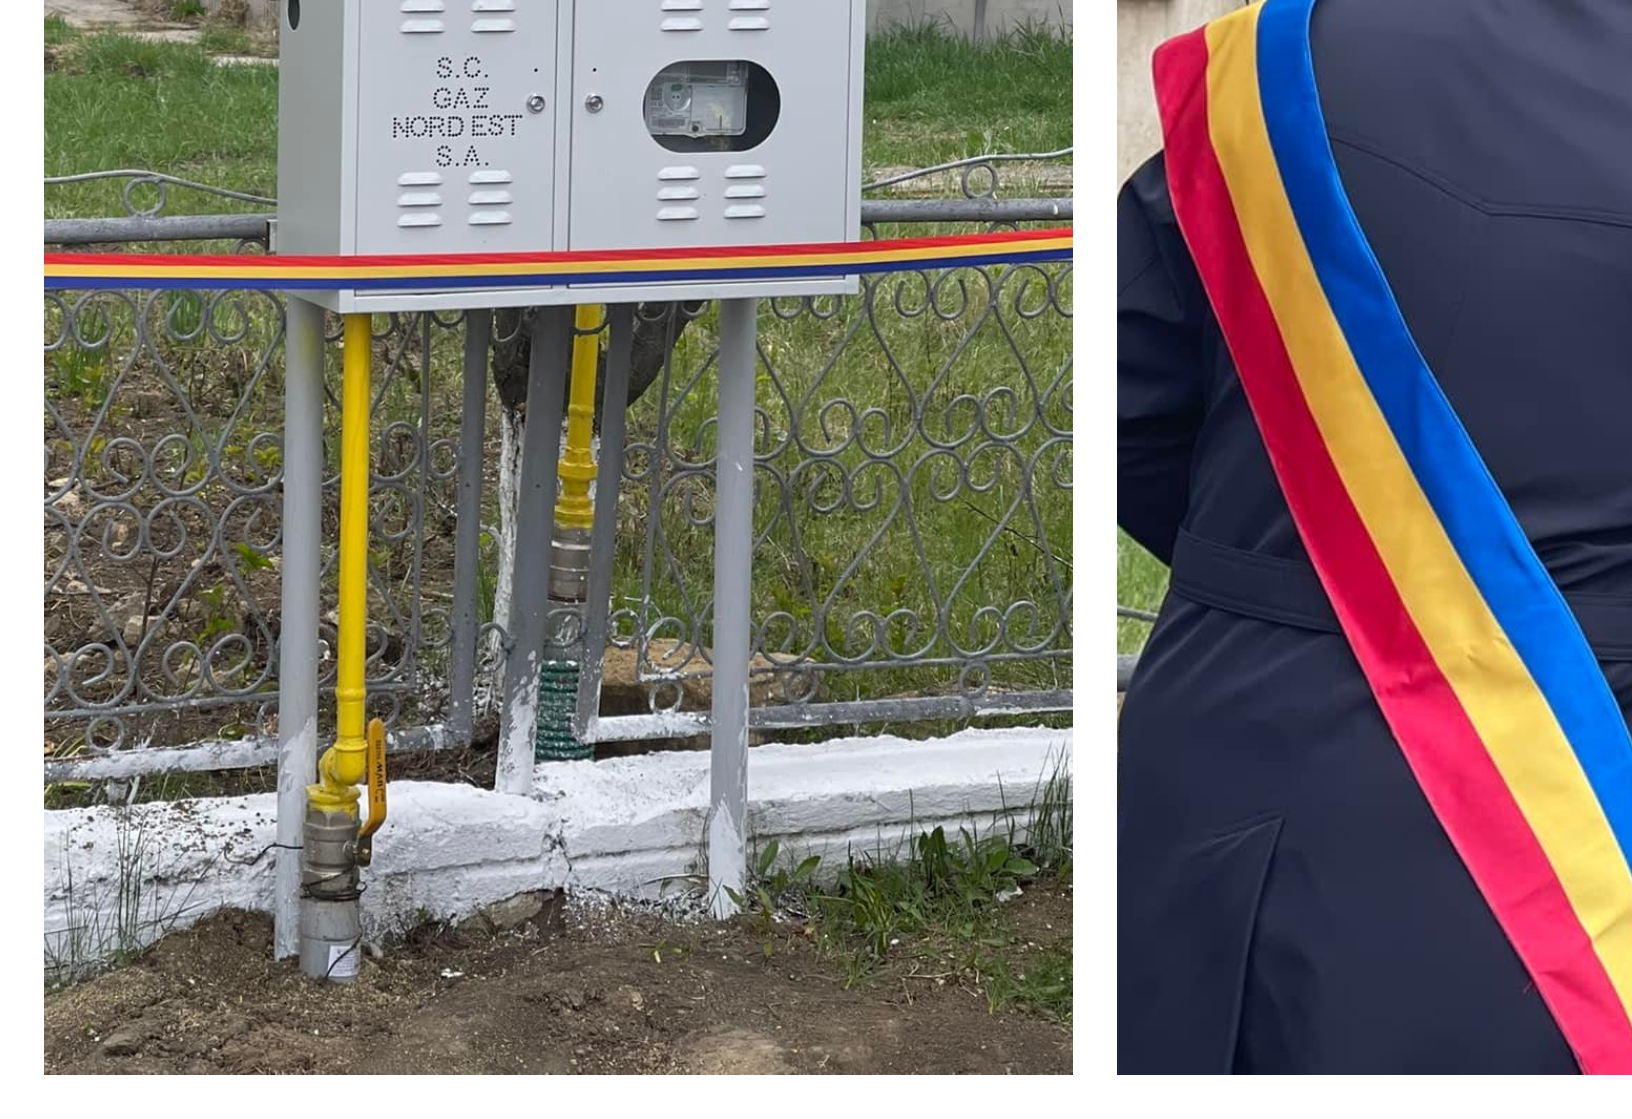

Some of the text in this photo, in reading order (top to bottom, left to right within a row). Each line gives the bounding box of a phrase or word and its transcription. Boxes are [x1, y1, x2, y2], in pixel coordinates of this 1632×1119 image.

[436, 56, 489, 79] S.C.
[433, 86, 490, 109] GAZ
[393, 113, 523, 139] NORD EST
[436, 144, 490, 167] S.A.
